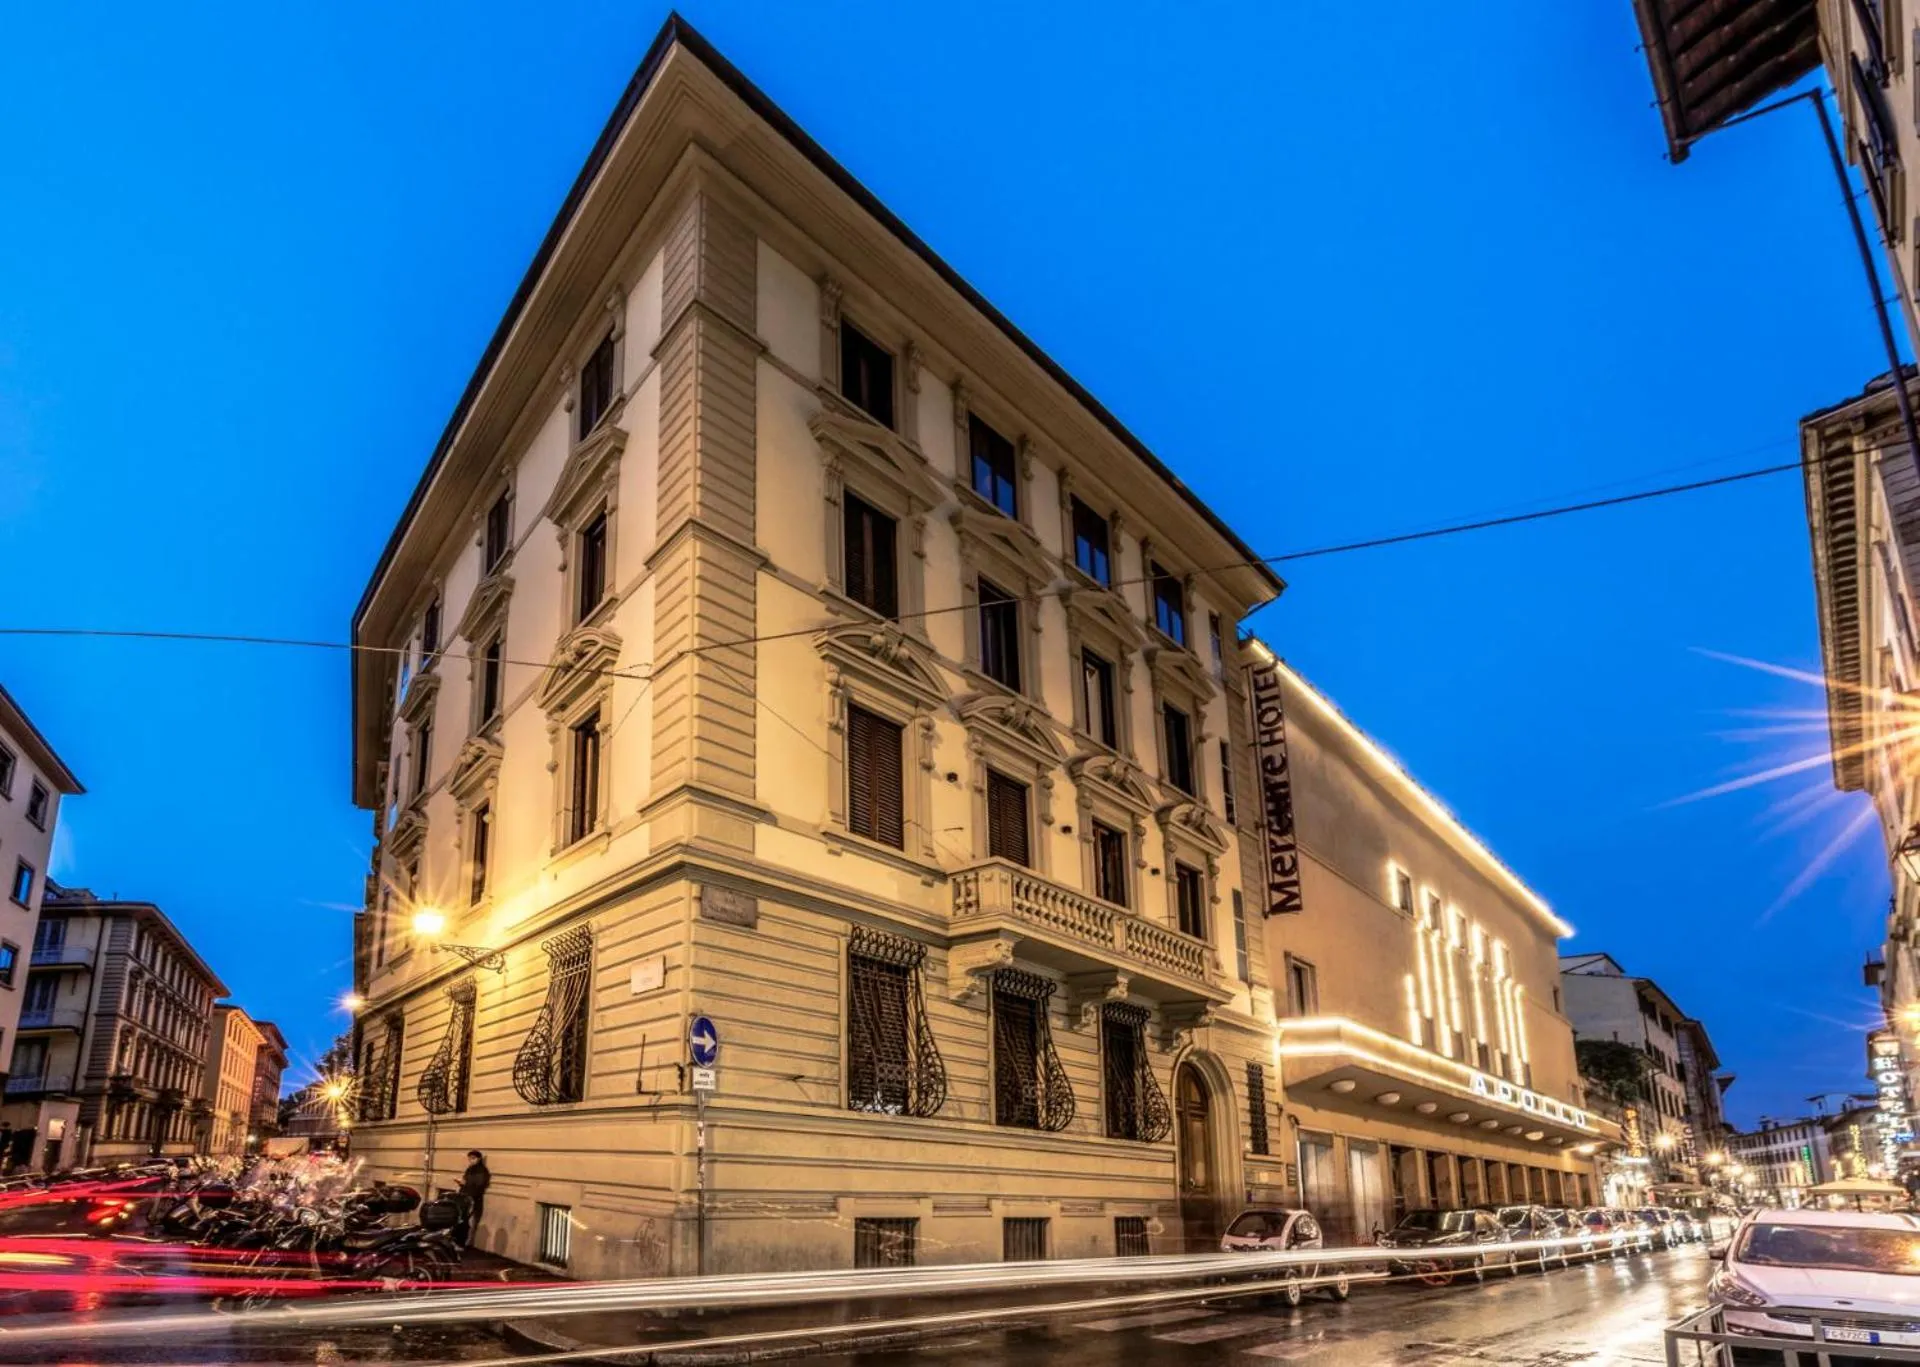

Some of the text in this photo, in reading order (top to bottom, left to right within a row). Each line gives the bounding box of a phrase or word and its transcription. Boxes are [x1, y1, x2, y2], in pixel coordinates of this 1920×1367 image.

[1254, 661, 1303, 915] Mercure HOTEL
[1471, 1076, 1586, 1128] APOLLO
